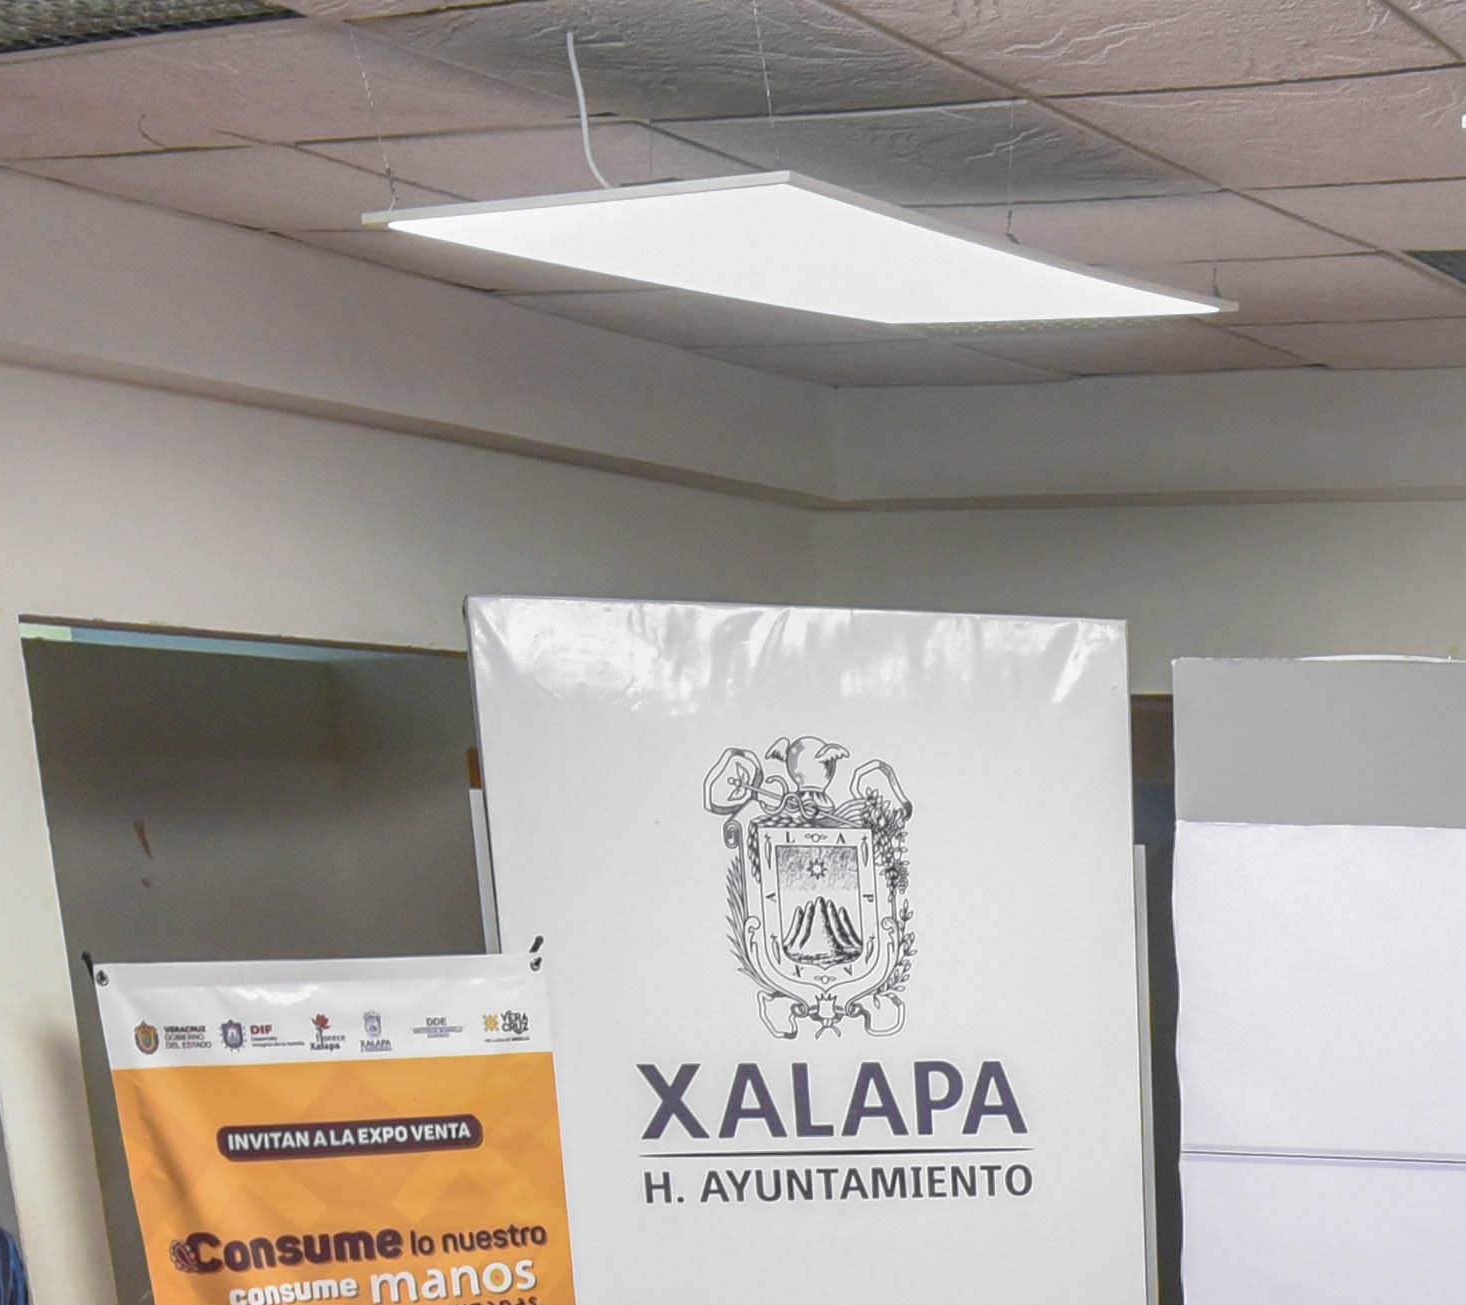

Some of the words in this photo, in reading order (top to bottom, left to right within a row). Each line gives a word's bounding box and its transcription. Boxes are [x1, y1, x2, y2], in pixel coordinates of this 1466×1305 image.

[249, 1024, 272, 1034] DIF
[634, 1059, 1029, 1140] XALAPA
[227, 1131, 310, 1151] INVITAN
[313, 1130, 328, 1147] A
[330, 1128, 355, 1146] LA
[357, 1126, 408, 1145] EXPO
[410, 1122, 471, 1142] VENTA
[644, 1170, 685, 1204] H.
[700, 1163, 1034, 1203] AYUNTAMIENTO
[185, 1229, 403, 1273] Consume
[409, 1230, 435, 1257] lo
[441, 1224, 548, 1254] nuestro
[370, 1259, 537, 1305] manos
